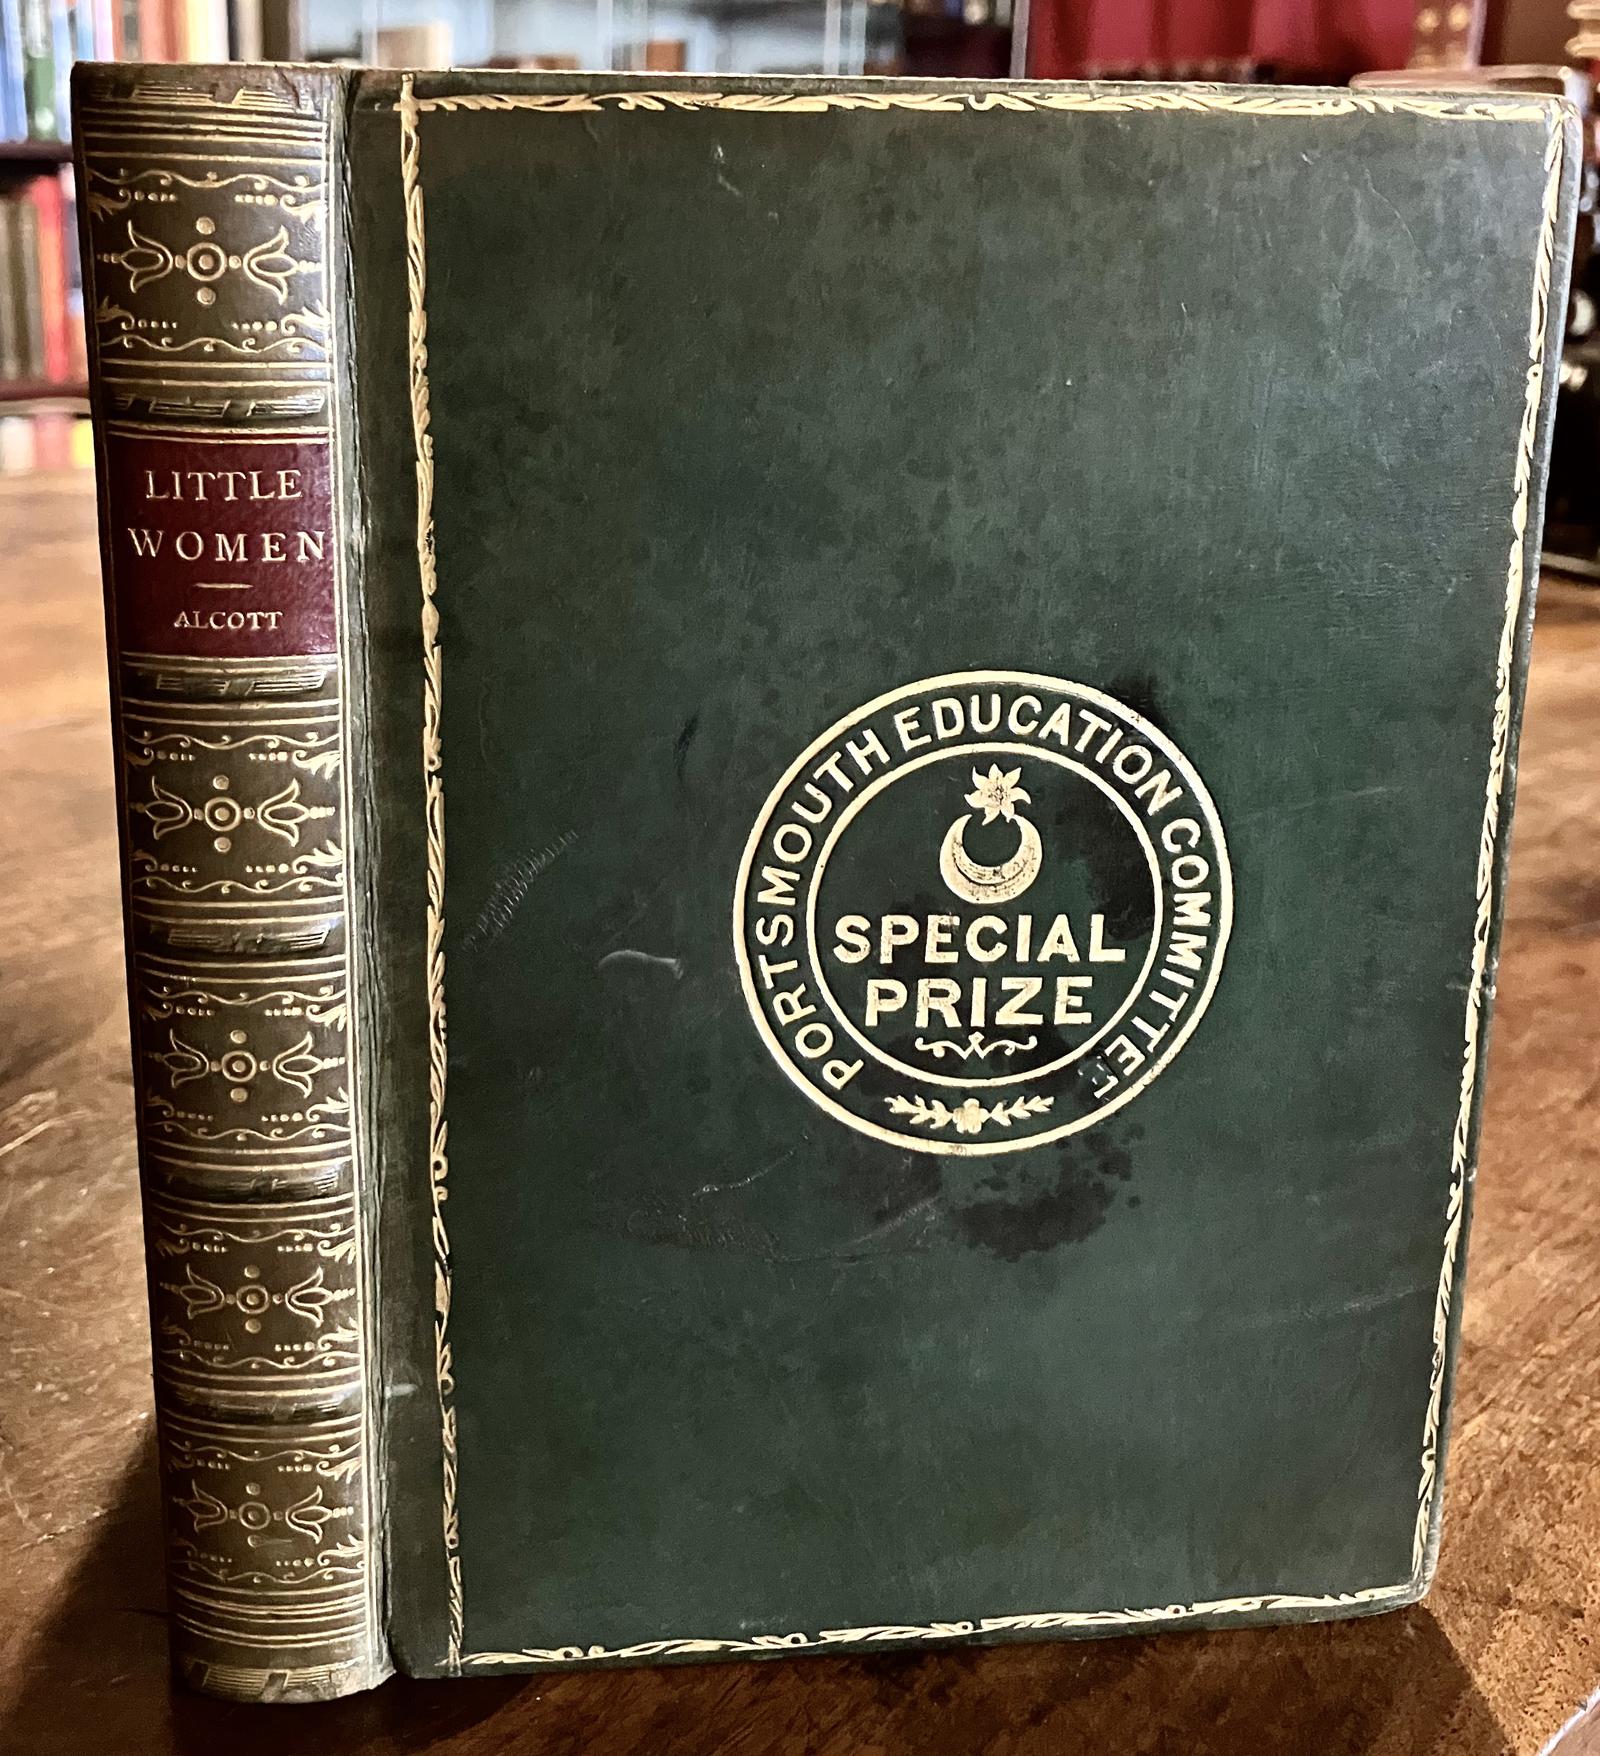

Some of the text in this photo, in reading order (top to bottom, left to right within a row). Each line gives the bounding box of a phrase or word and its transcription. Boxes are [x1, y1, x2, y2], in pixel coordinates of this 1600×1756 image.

[145, 469, 303, 501] LITTLE
[127, 527, 326, 562] WOMEN
[174, 610, 283, 630] ALCOTT
[755, 729, 890, 1090] PORTSMOUTH
[893, 693, 1184, 816] EDUCATION
[833, 914, 1126, 964] SPECIAL
[864, 976, 1093, 1029] PRIZE
